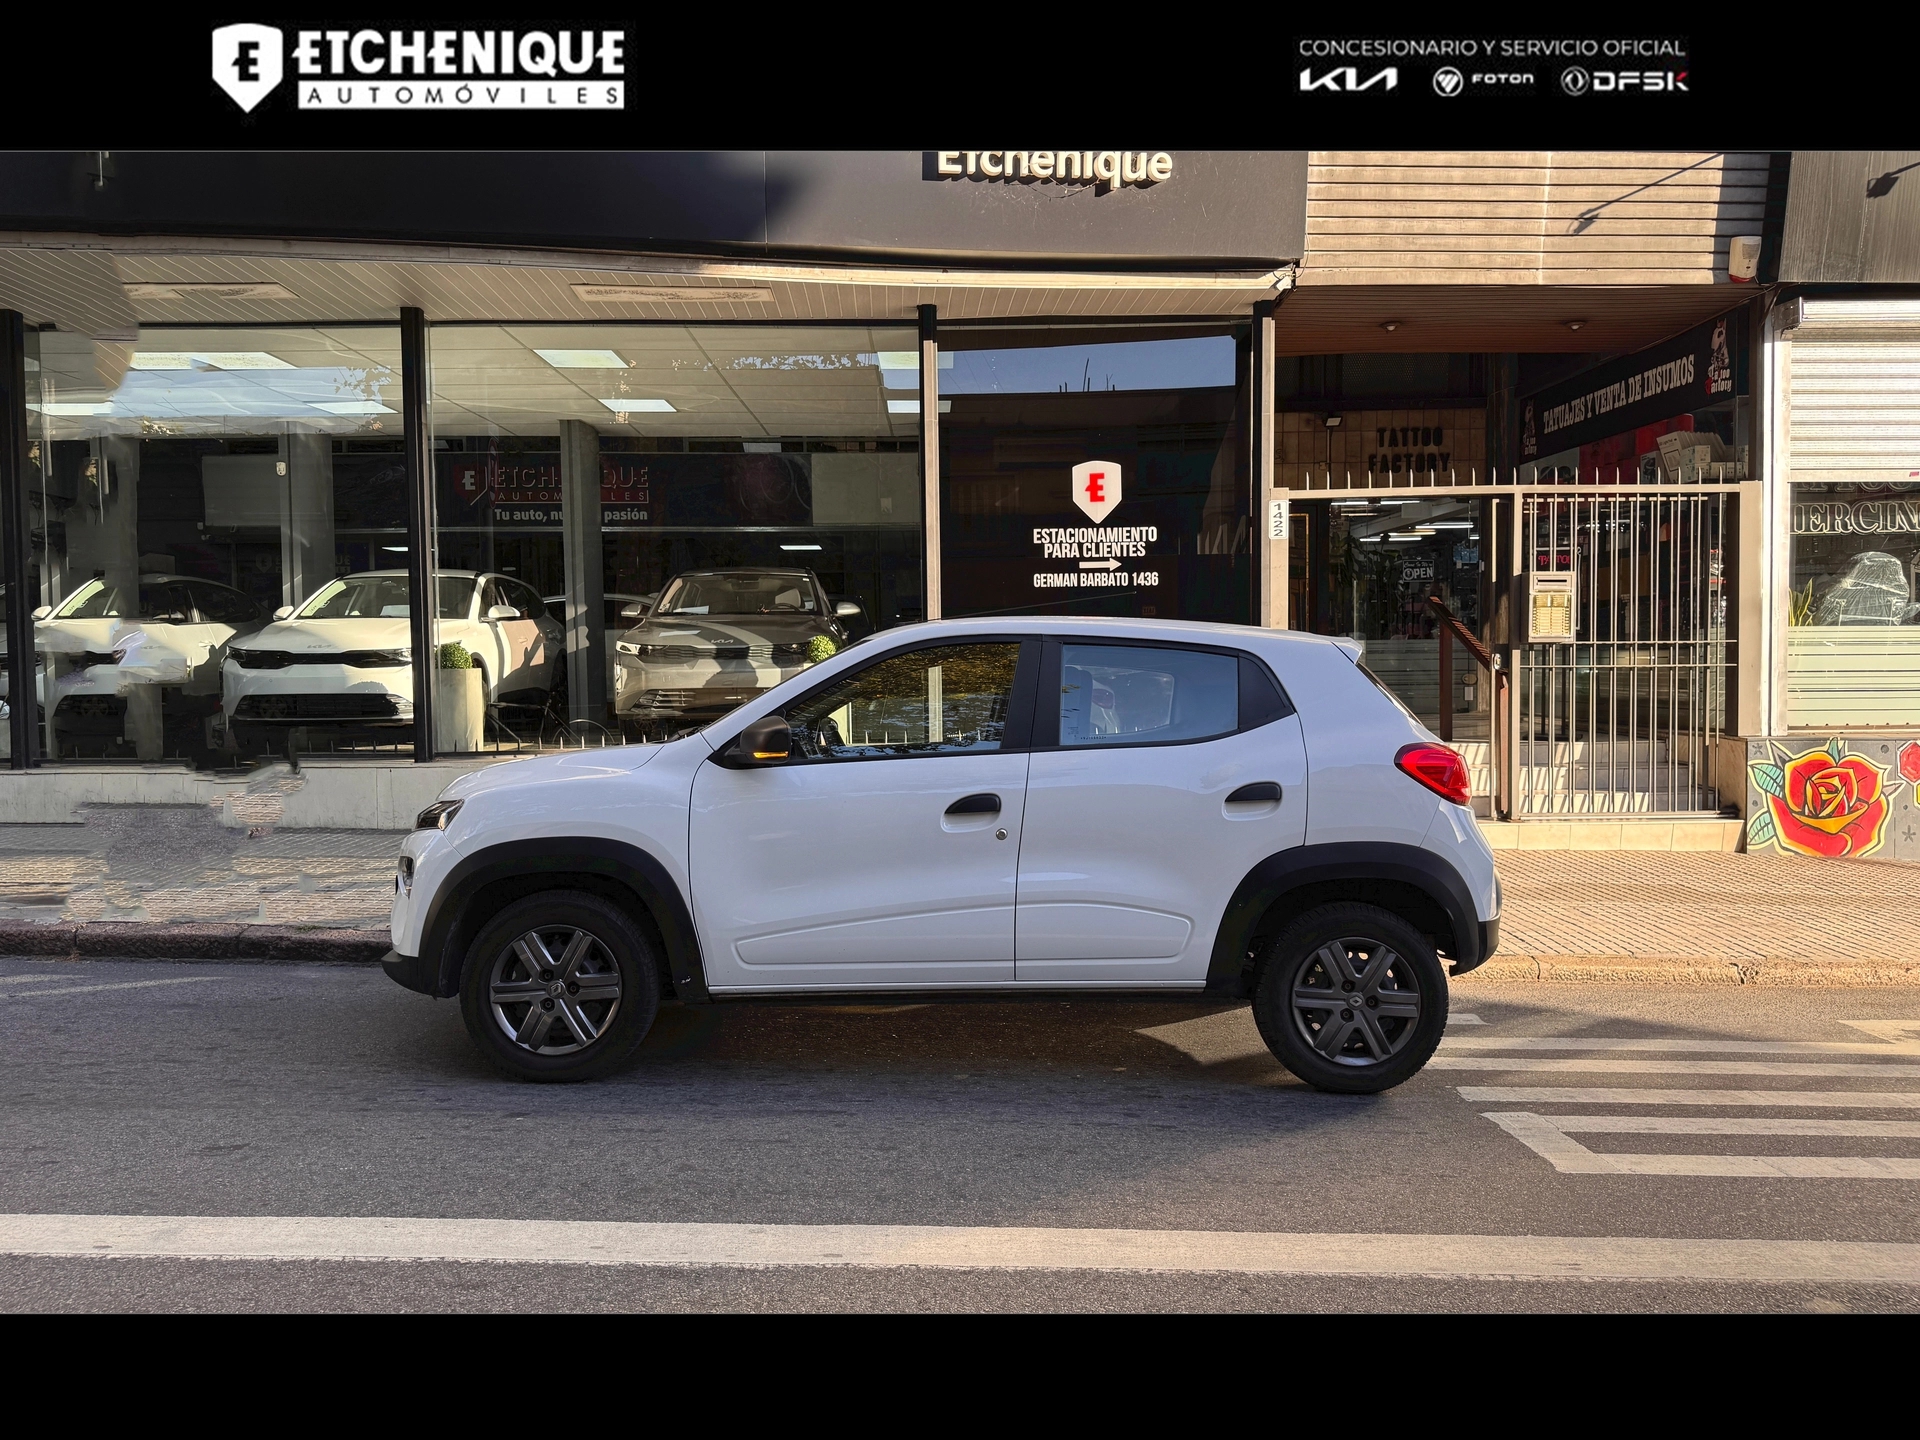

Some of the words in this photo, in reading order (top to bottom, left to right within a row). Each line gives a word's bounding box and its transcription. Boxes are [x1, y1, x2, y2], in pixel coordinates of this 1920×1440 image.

[1543, 395, 1585, 434] TATUAJES
[1586, 393, 1595, 418] Y
[1594, 380, 1627, 415] VENTA
[1628, 374, 1642, 403] DE
[1643, 353, 1695, 398] INSUMOS
[1376, 426, 1444, 447] TATTOO
[1368, 453, 1450, 474] FACTORY
[491, 466, 648, 489] ETCHQUE
[498, 491, 645, 501] AUTOMLES
[494, 508, 510, 521] Tu
[513, 508, 547, 523] auto,
[604, 508, 648, 523] pasión
[1273, 502, 1284, 537] 1422
[1033, 526, 1158, 544] ESTACIONAMIENTO
[1044, 543, 1080, 558] PARA
[1083, 541, 1146, 557] CLIENTES
[1033, 573, 1078, 588] GERMAN
[1080, 572, 1129, 587] BARBATO
[1132, 571, 1159, 586] 1436
[1403, 567, 1434, 580] OPEN
